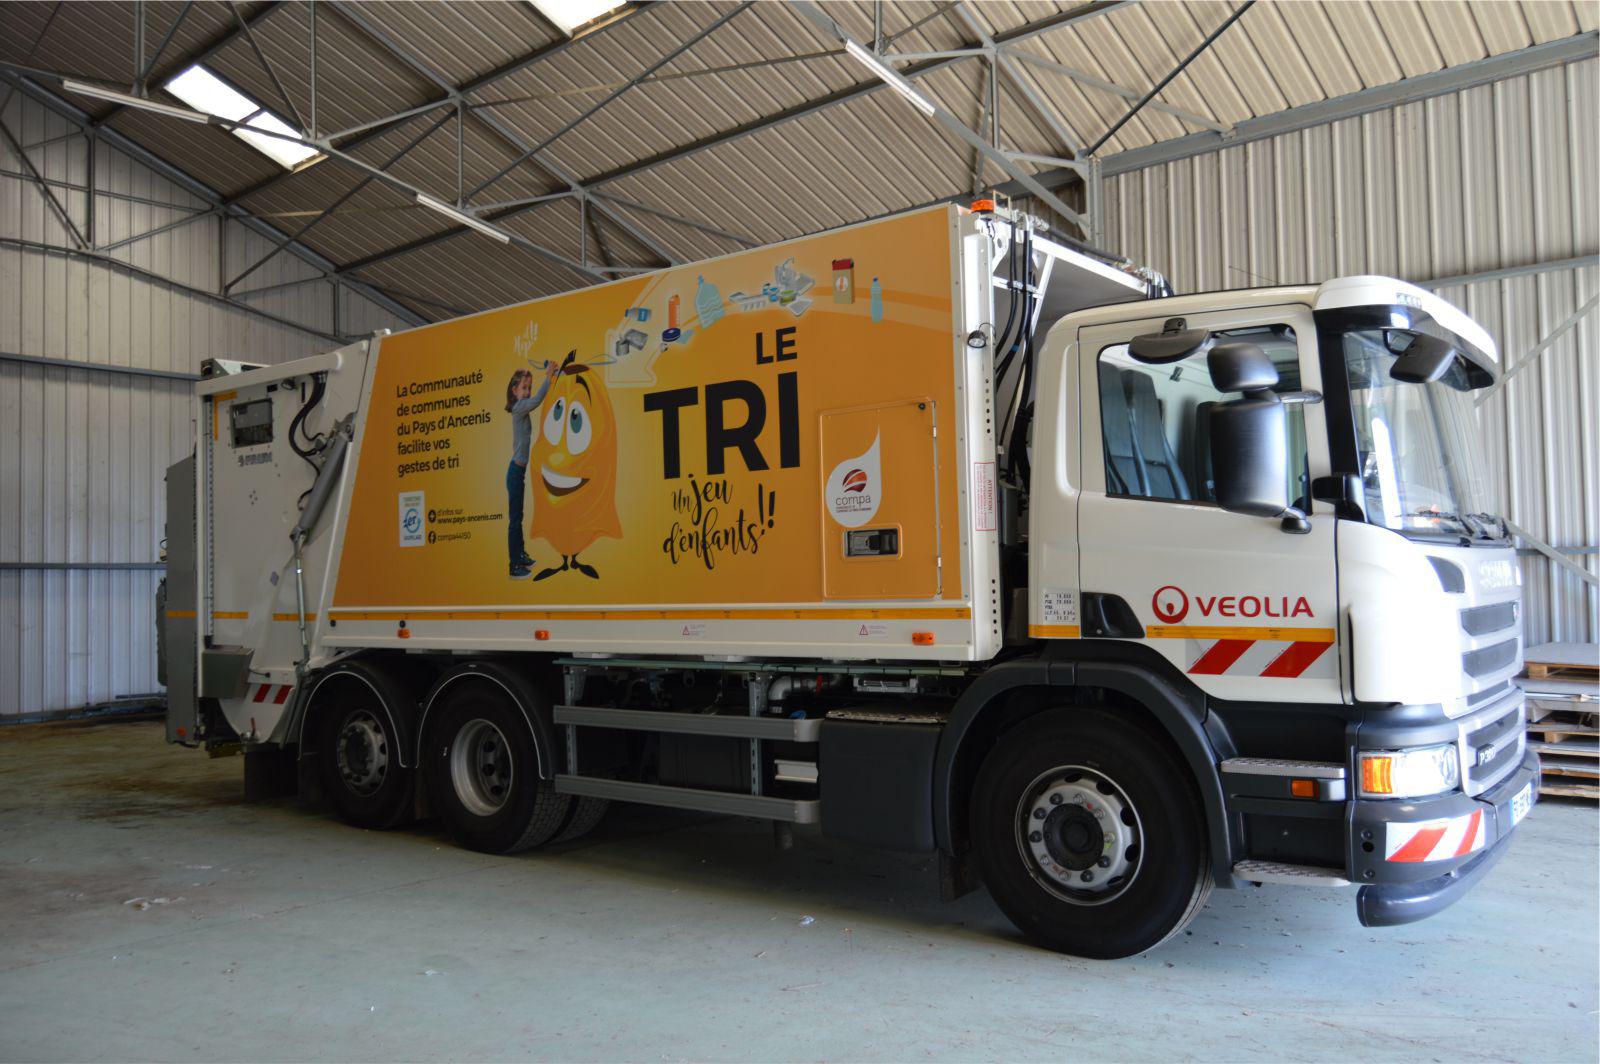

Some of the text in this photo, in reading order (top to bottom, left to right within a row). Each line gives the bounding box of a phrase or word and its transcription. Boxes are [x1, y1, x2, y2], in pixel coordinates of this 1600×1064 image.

[756, 326, 797, 365] LE
[396, 369, 483, 398] La Communauté
[396, 395, 471, 417] de communes
[396, 409, 491, 436] du Pays d'Ancenis
[643, 371, 801, 480] TRI
[397, 438, 450, 456] facilite vos
[397, 453, 459, 478] gestes de tri
[689, 473, 733, 526] jeu
[835, 494, 872, 508] compa
[437, 512, 503, 525] www.pays-ancenis.com
[1195, 596, 1314, 618] VEOLIA
